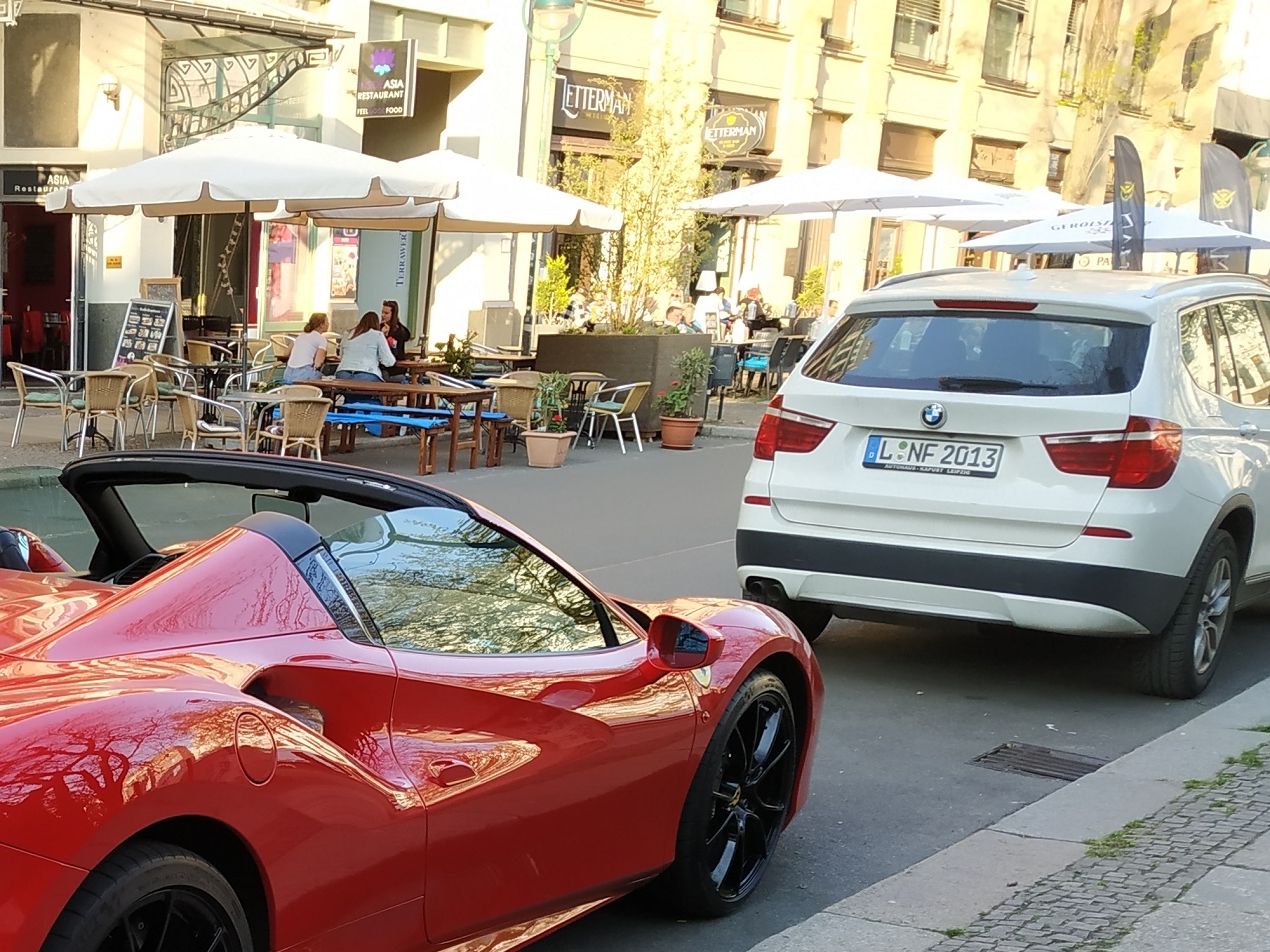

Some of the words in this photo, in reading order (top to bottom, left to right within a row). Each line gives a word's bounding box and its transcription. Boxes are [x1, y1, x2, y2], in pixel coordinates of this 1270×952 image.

[383, 79, 405, 90] ASIA
[357, 90, 405, 101] RESTAURANT
[552, 73, 633, 118] LETTERMAN
[385, 106, 403, 114] FOOD
[704, 126, 757, 141] LETTERMAN
[47, 174, 70, 185] ASIA
[14, 185, 68, 193] Restaura
[879, 440, 893, 460] L
[907, 442, 938, 463] NF
[940, 444, 998, 468] 2013
